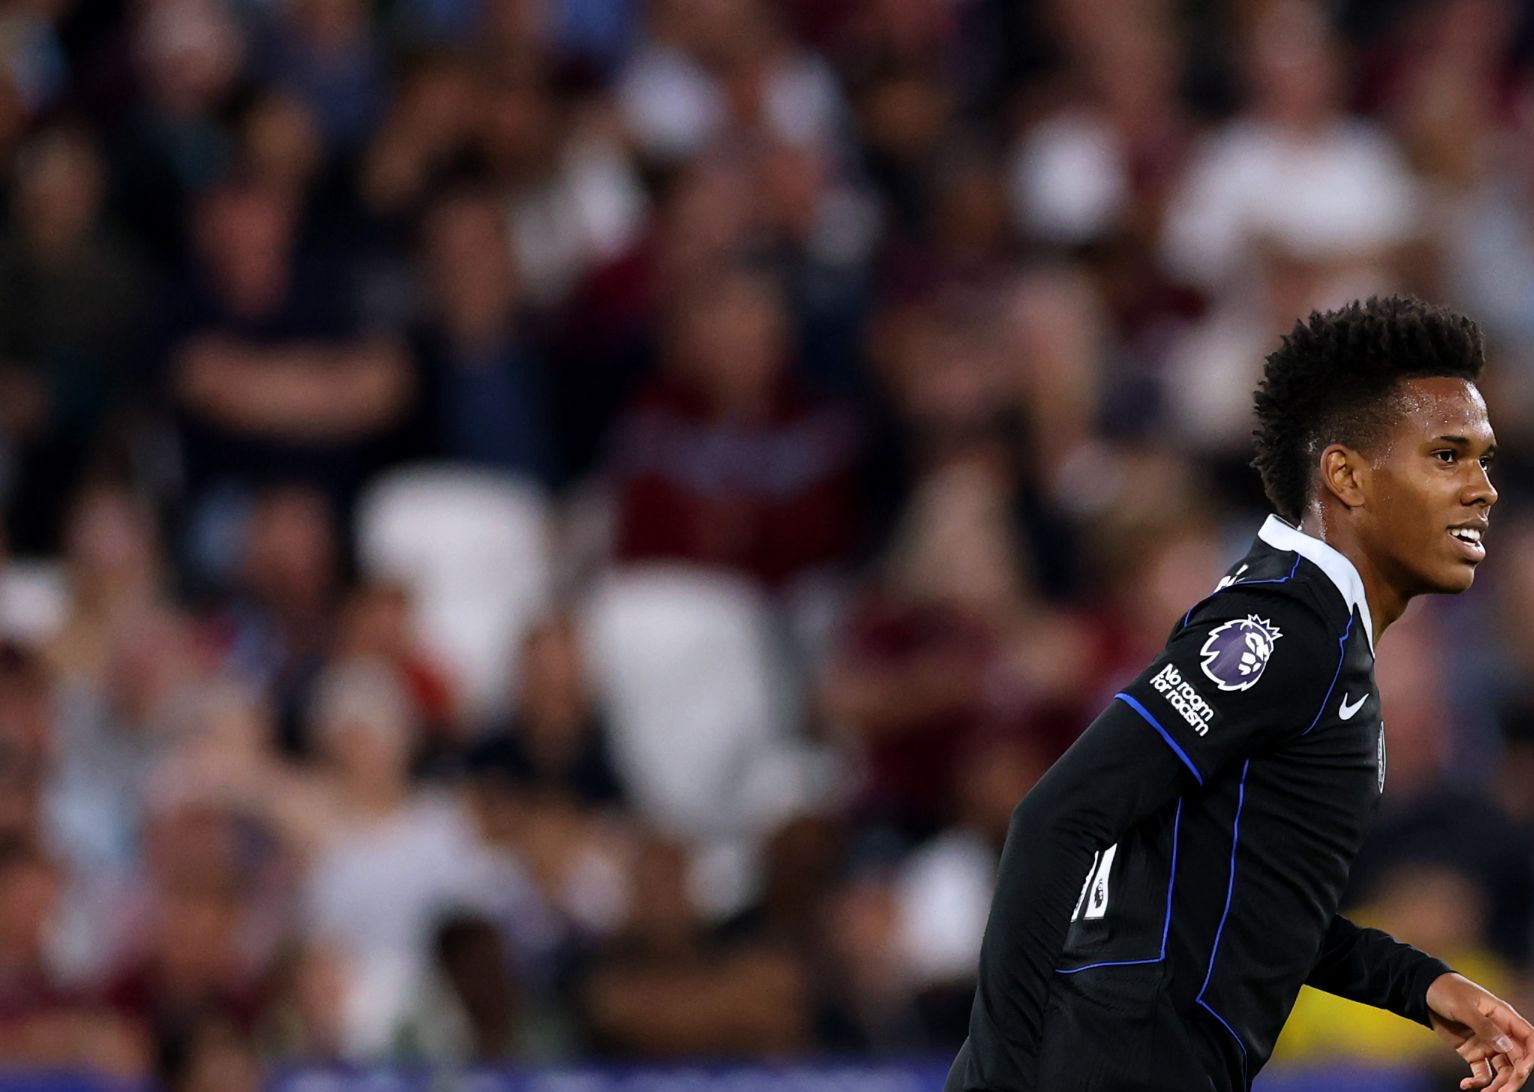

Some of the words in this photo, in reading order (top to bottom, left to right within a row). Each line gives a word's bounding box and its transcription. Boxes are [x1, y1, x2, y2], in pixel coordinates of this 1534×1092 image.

[1149, 673, 1173, 693] for
[1165, 689, 1209, 737] racism
[1160, 663, 1181, 685] No
[1176, 681, 1214, 722] room
